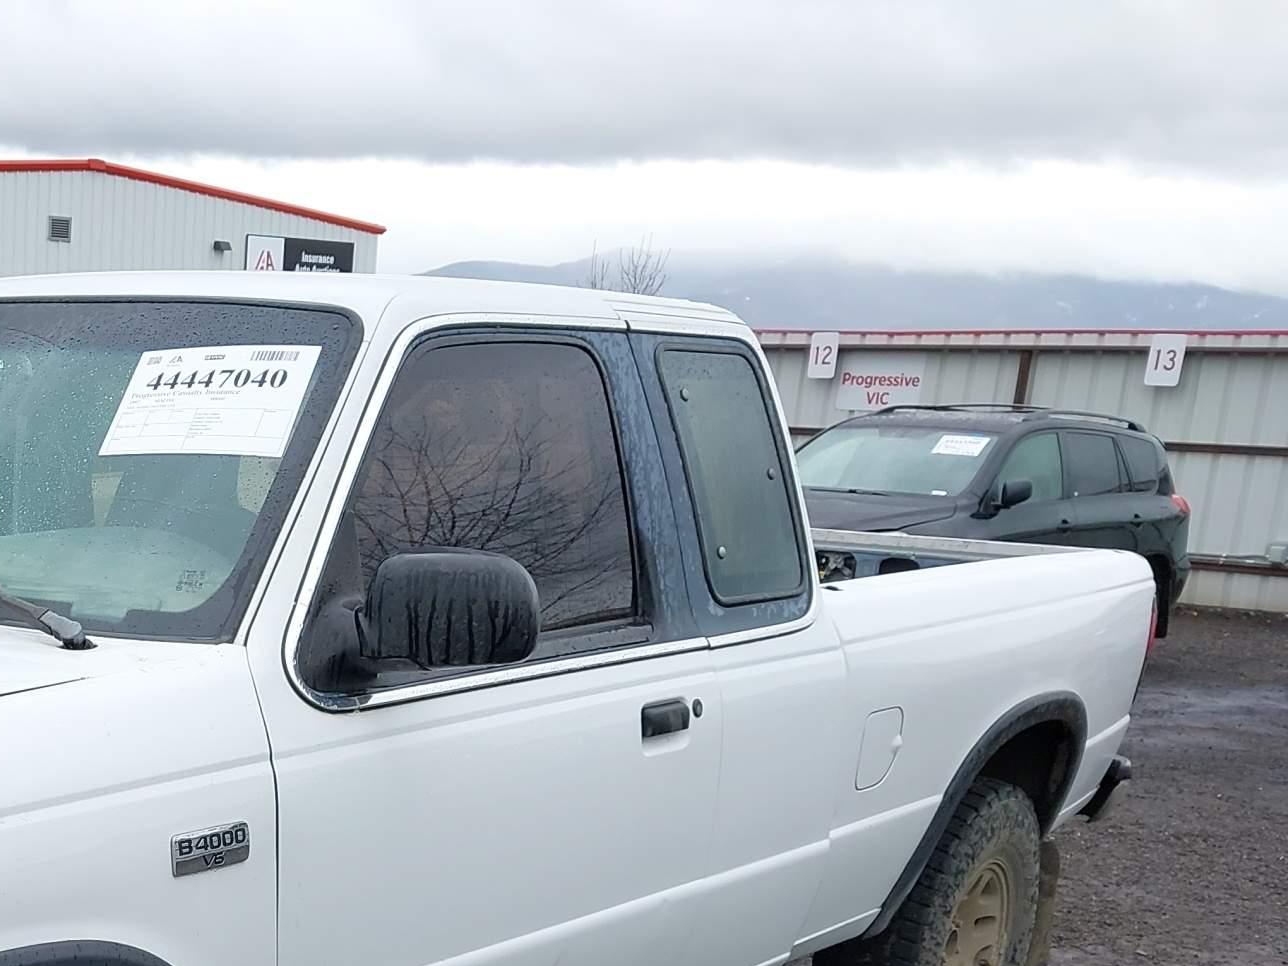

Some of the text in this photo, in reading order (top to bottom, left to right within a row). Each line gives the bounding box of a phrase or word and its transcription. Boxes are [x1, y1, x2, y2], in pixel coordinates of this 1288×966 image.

[301, 251, 335, 264] Insurance
[814, 345, 833, 366] 12
[1153, 349, 1177, 371] 13
[146, 368, 288, 391] 44447040
[842, 372, 921, 388] Progressive
[866, 391, 890, 405] VIC
[178, 828, 247, 857] B4000
[202, 850, 225, 868] V6
